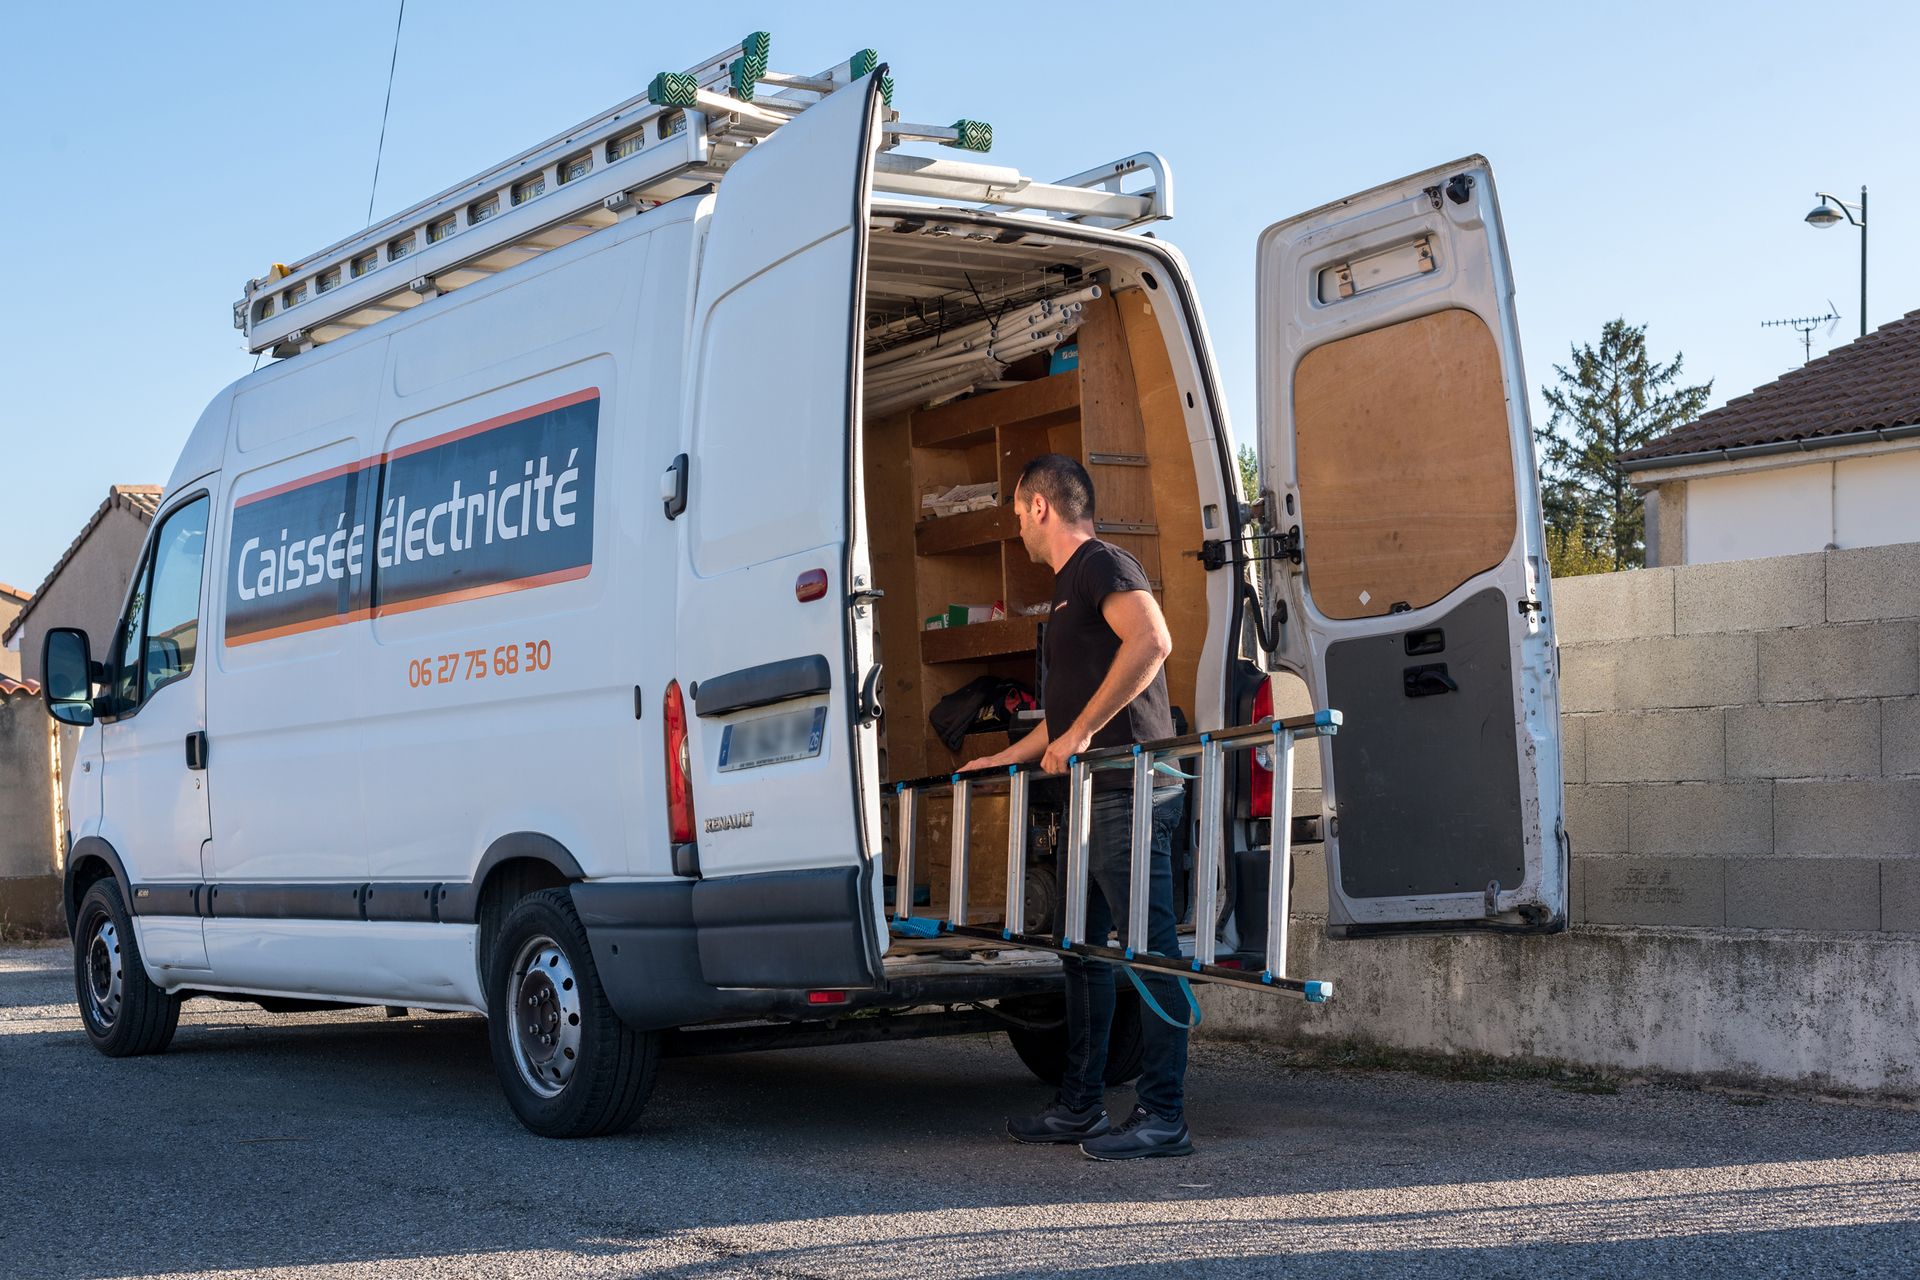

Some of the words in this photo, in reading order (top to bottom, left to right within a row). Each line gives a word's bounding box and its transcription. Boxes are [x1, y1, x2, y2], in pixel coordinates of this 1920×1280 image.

[237, 512, 365, 601] Caissée
[377, 447, 579, 569] électricité
[409, 657, 432, 688] 06
[438, 653, 460, 684] 27
[464, 649, 488, 681] 75
[493, 644, 519, 676] 68
[525, 639, 552, 672] 30
[704, 810, 754, 833] RENAULT
